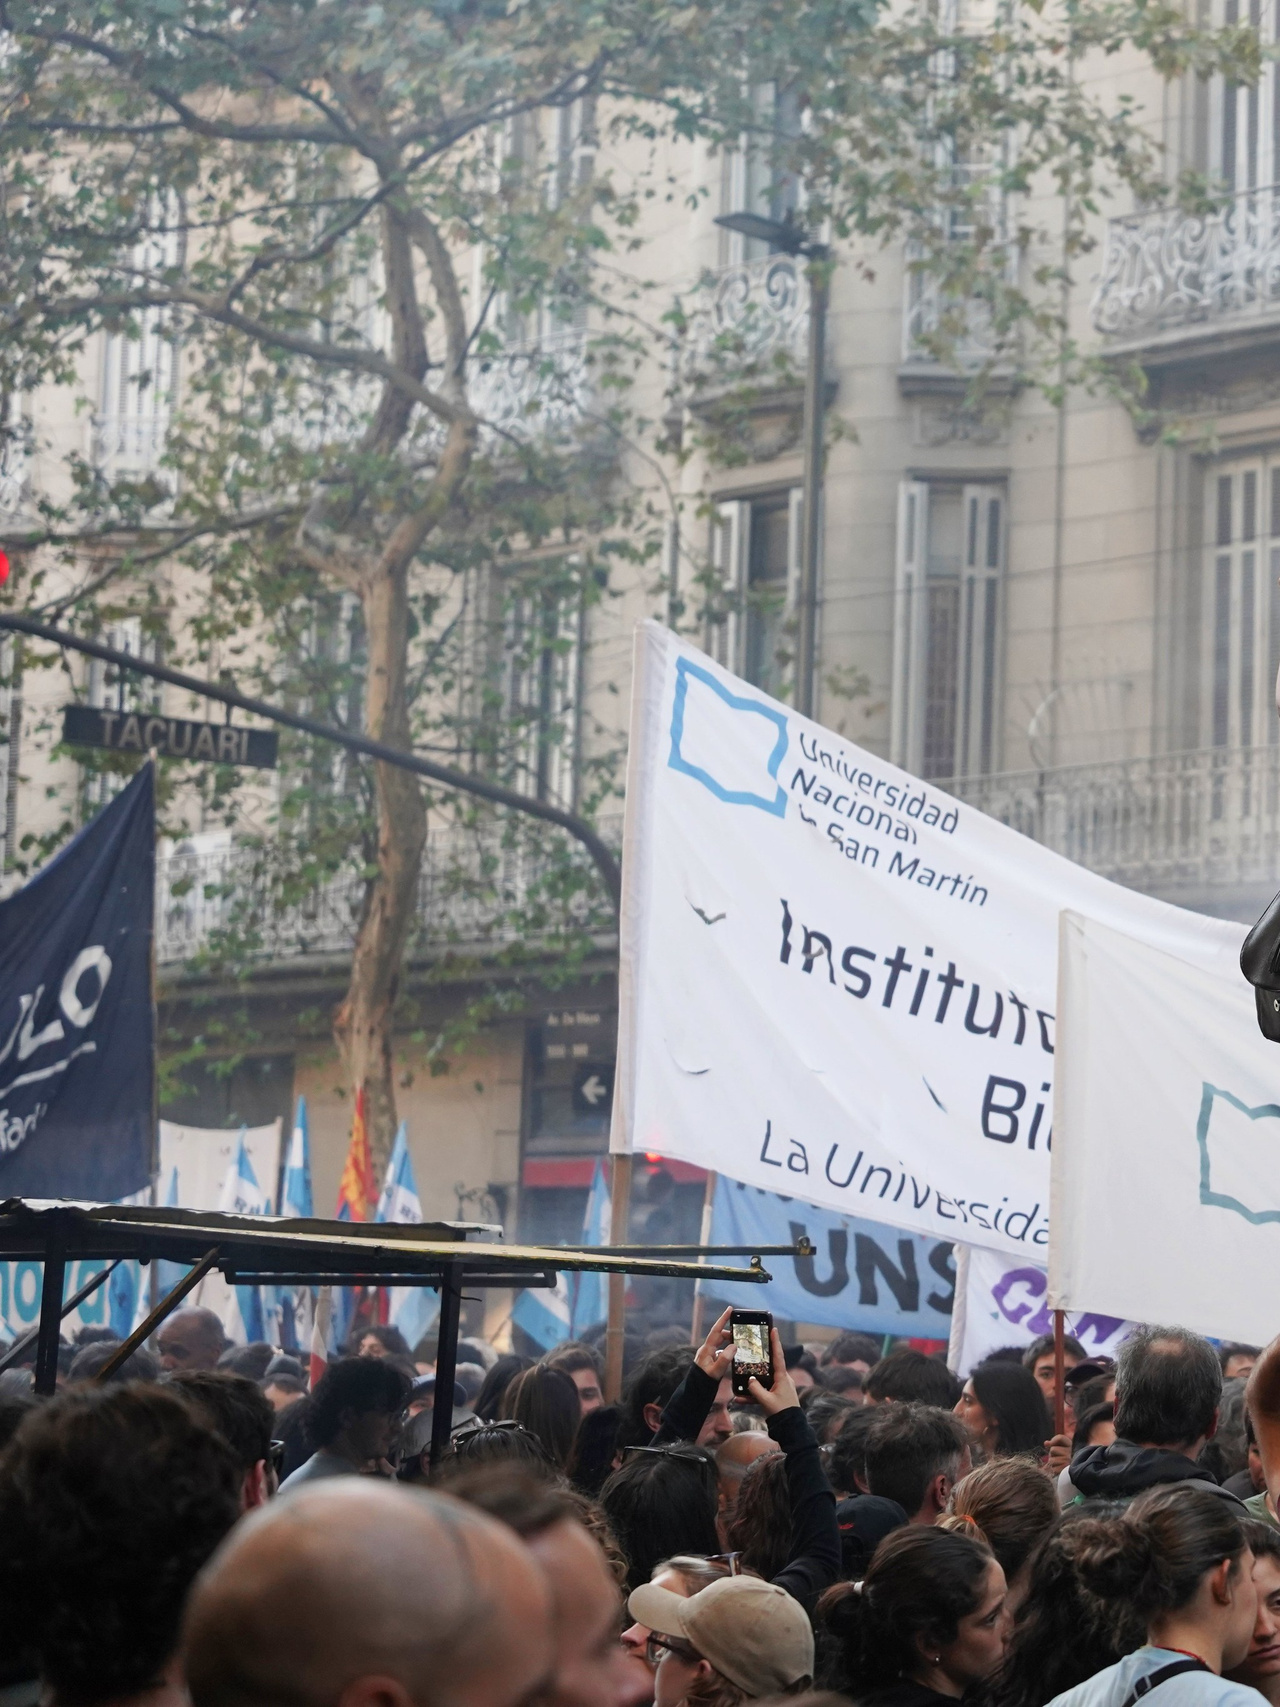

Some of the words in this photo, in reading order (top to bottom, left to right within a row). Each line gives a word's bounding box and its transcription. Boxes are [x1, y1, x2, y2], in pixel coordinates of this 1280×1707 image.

[101, 711, 250, 764] TACUARI
[791, 767, 918, 845] Nacional
[800, 733, 959, 835] Universidad
[827, 822, 880, 868] San
[888, 851, 989, 906] Martín
[780, 897, 1056, 1055] Instituto
[760, 1119, 809, 1175] La
[981, 1074, 1054, 1153] Bi
